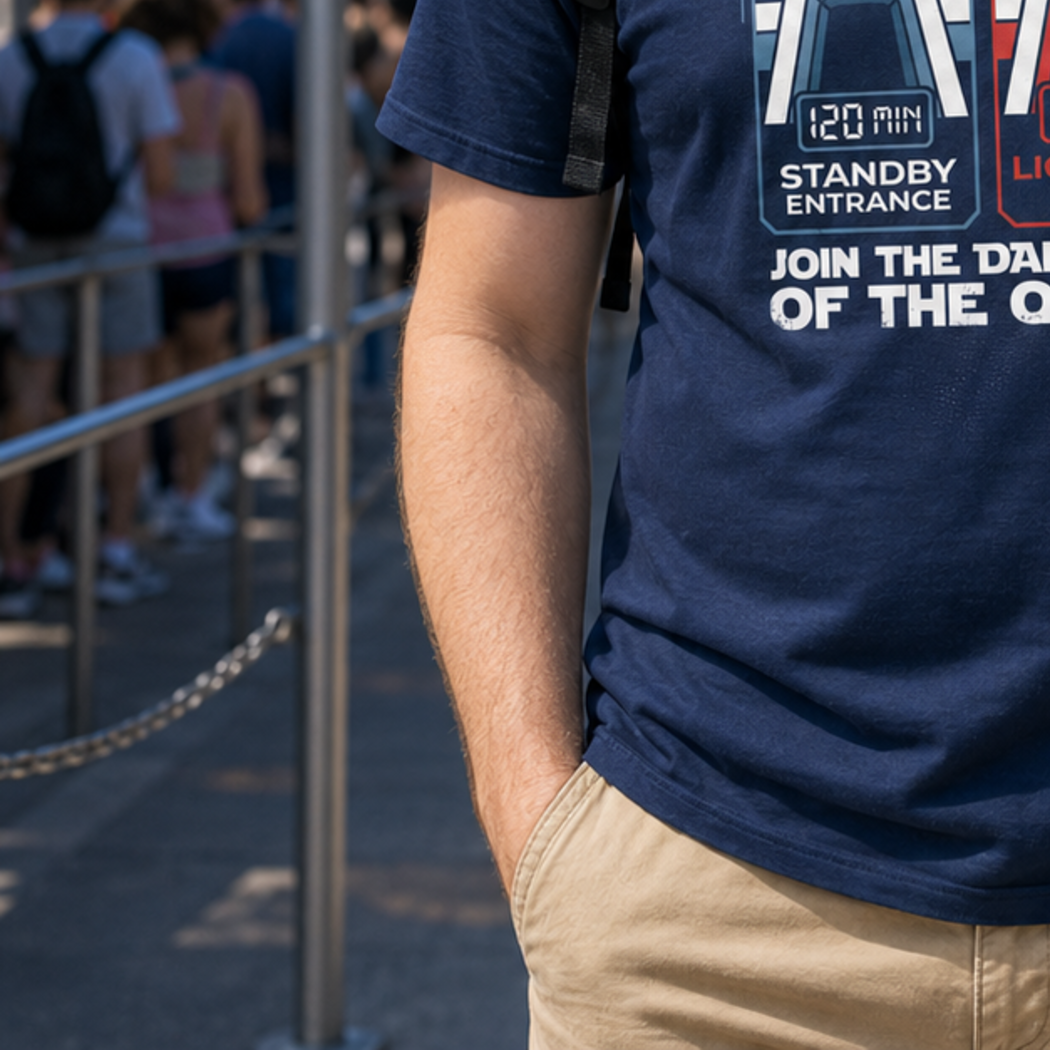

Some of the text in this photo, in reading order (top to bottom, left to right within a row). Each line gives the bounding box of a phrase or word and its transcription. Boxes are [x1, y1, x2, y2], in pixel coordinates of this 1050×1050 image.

[810, 103, 921, 140] 120 MIN
[781, 159, 956, 189] STANDBY
[787, 188, 951, 214] ENTRANCE
[771, 247, 859, 280] JOIN
[874, 244, 961, 277] THE
[770, 286, 849, 331] OF
[868, 282, 988, 328] THE
